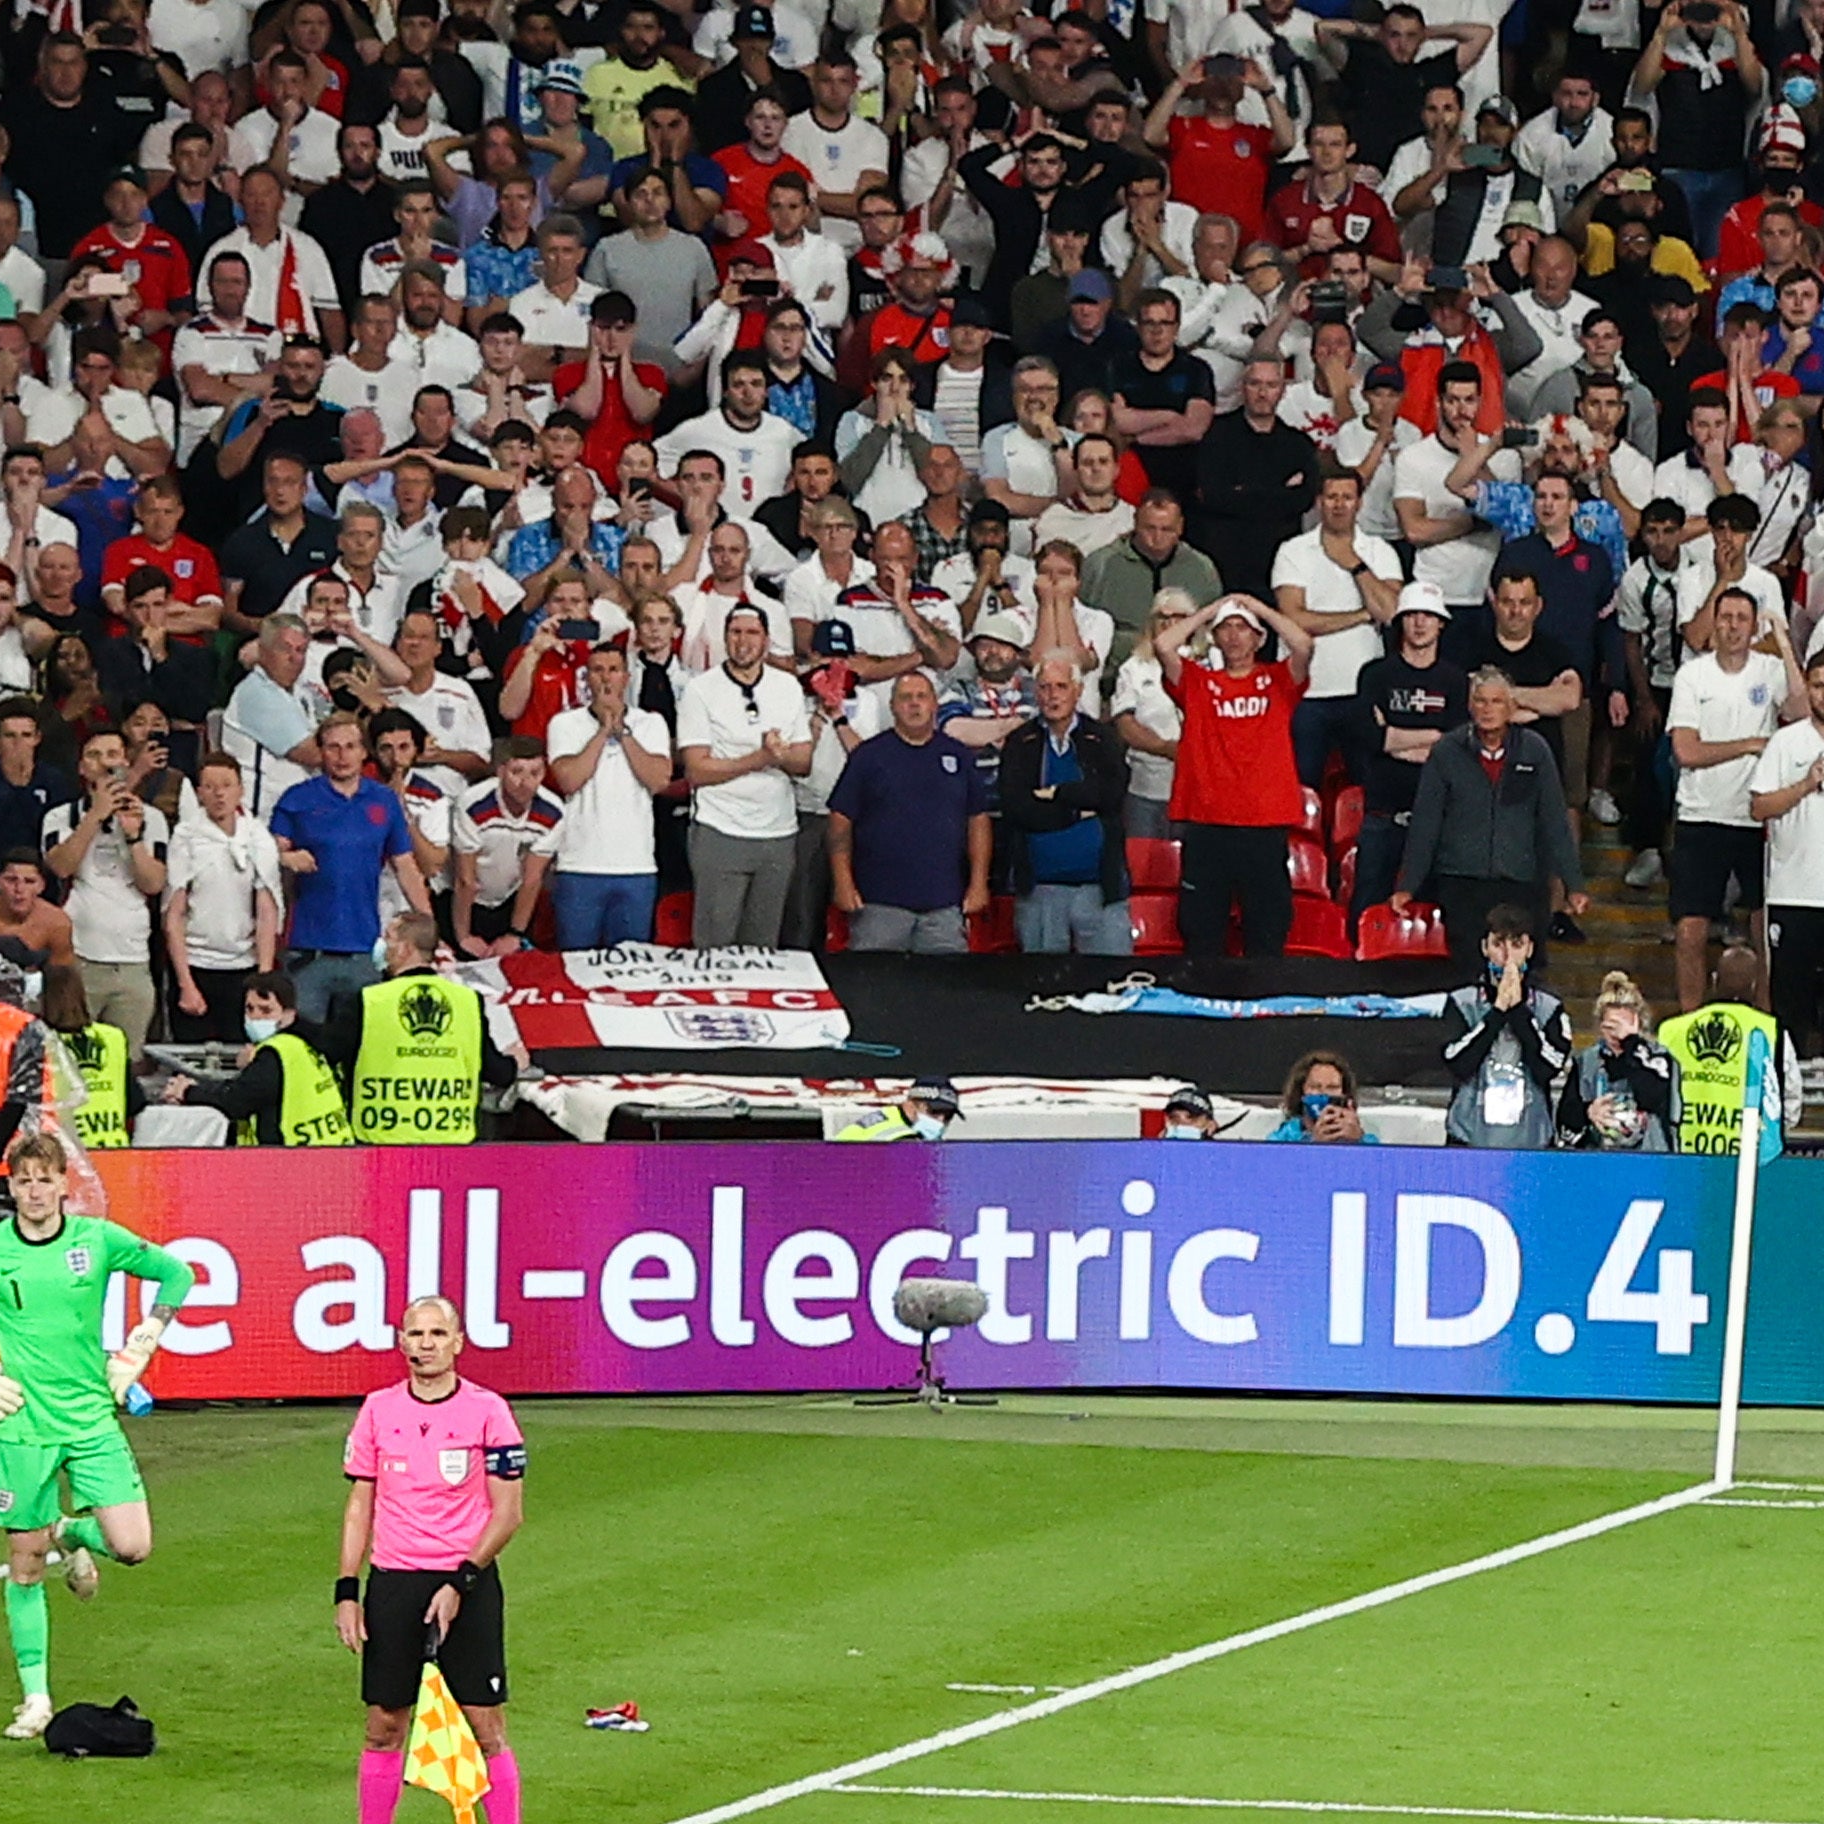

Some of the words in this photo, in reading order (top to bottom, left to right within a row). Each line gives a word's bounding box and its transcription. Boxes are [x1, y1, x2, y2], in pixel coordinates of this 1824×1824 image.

[741, 475, 754, 501] 9
[588, 949, 653, 966] JON
[293, 1178, 1261, 1353] all-electric
[1327, 1190, 1710, 1355] ID.4
[10, 1279, 23, 1311] 1
